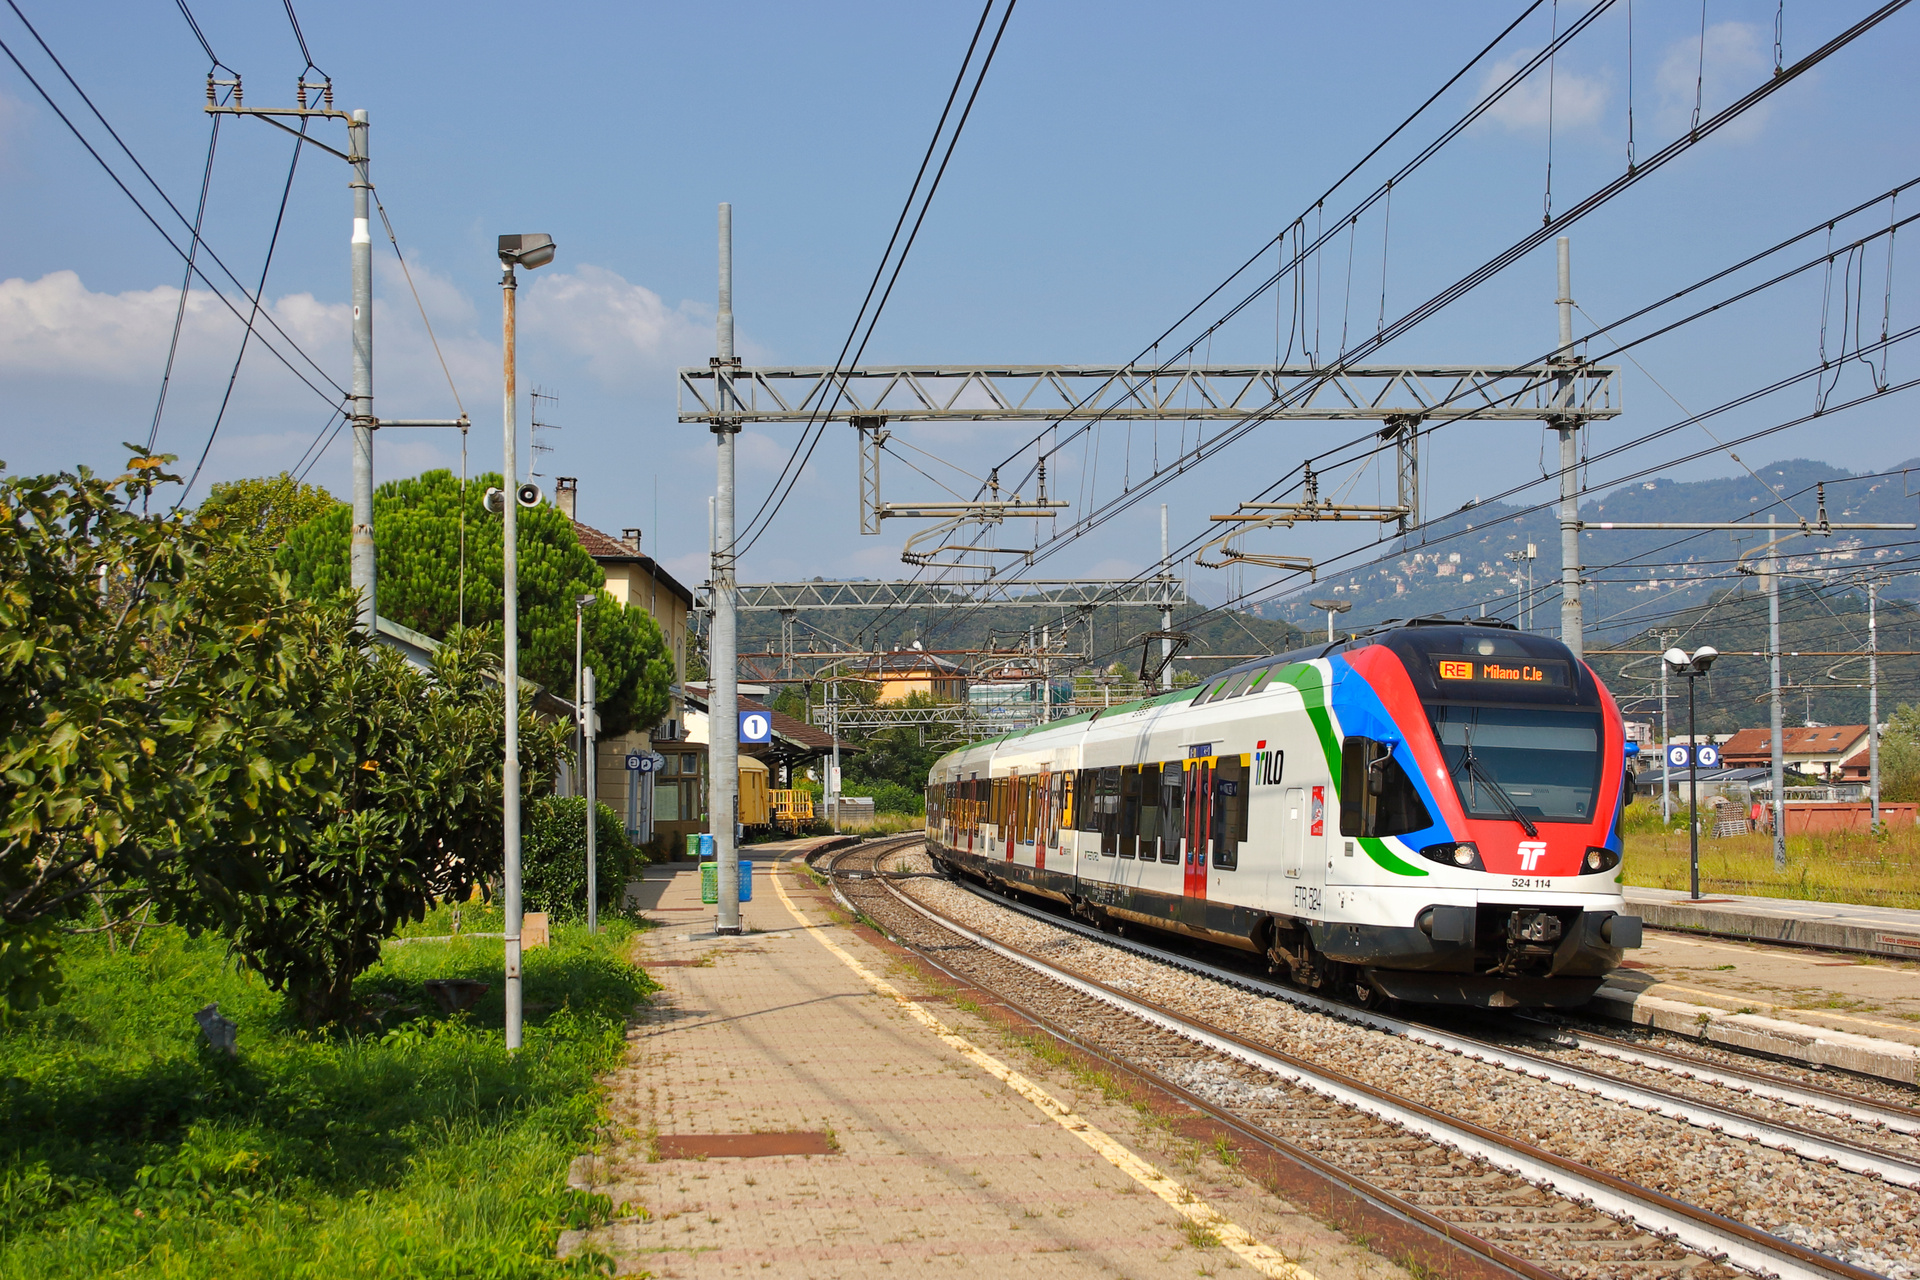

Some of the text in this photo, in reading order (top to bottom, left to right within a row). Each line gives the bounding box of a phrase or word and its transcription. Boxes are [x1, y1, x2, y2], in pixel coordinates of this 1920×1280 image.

[1445, 663, 1543, 681] RE Milano C.le
[751, 719, 758, 735] 1
[1255, 739, 1284, 786] TILO
[1674, 751, 1683, 762] 3
[1702, 751, 1712, 762] 4
[1511, 878, 1551, 888] 524 114
[1308, 887, 1322, 911] 524
